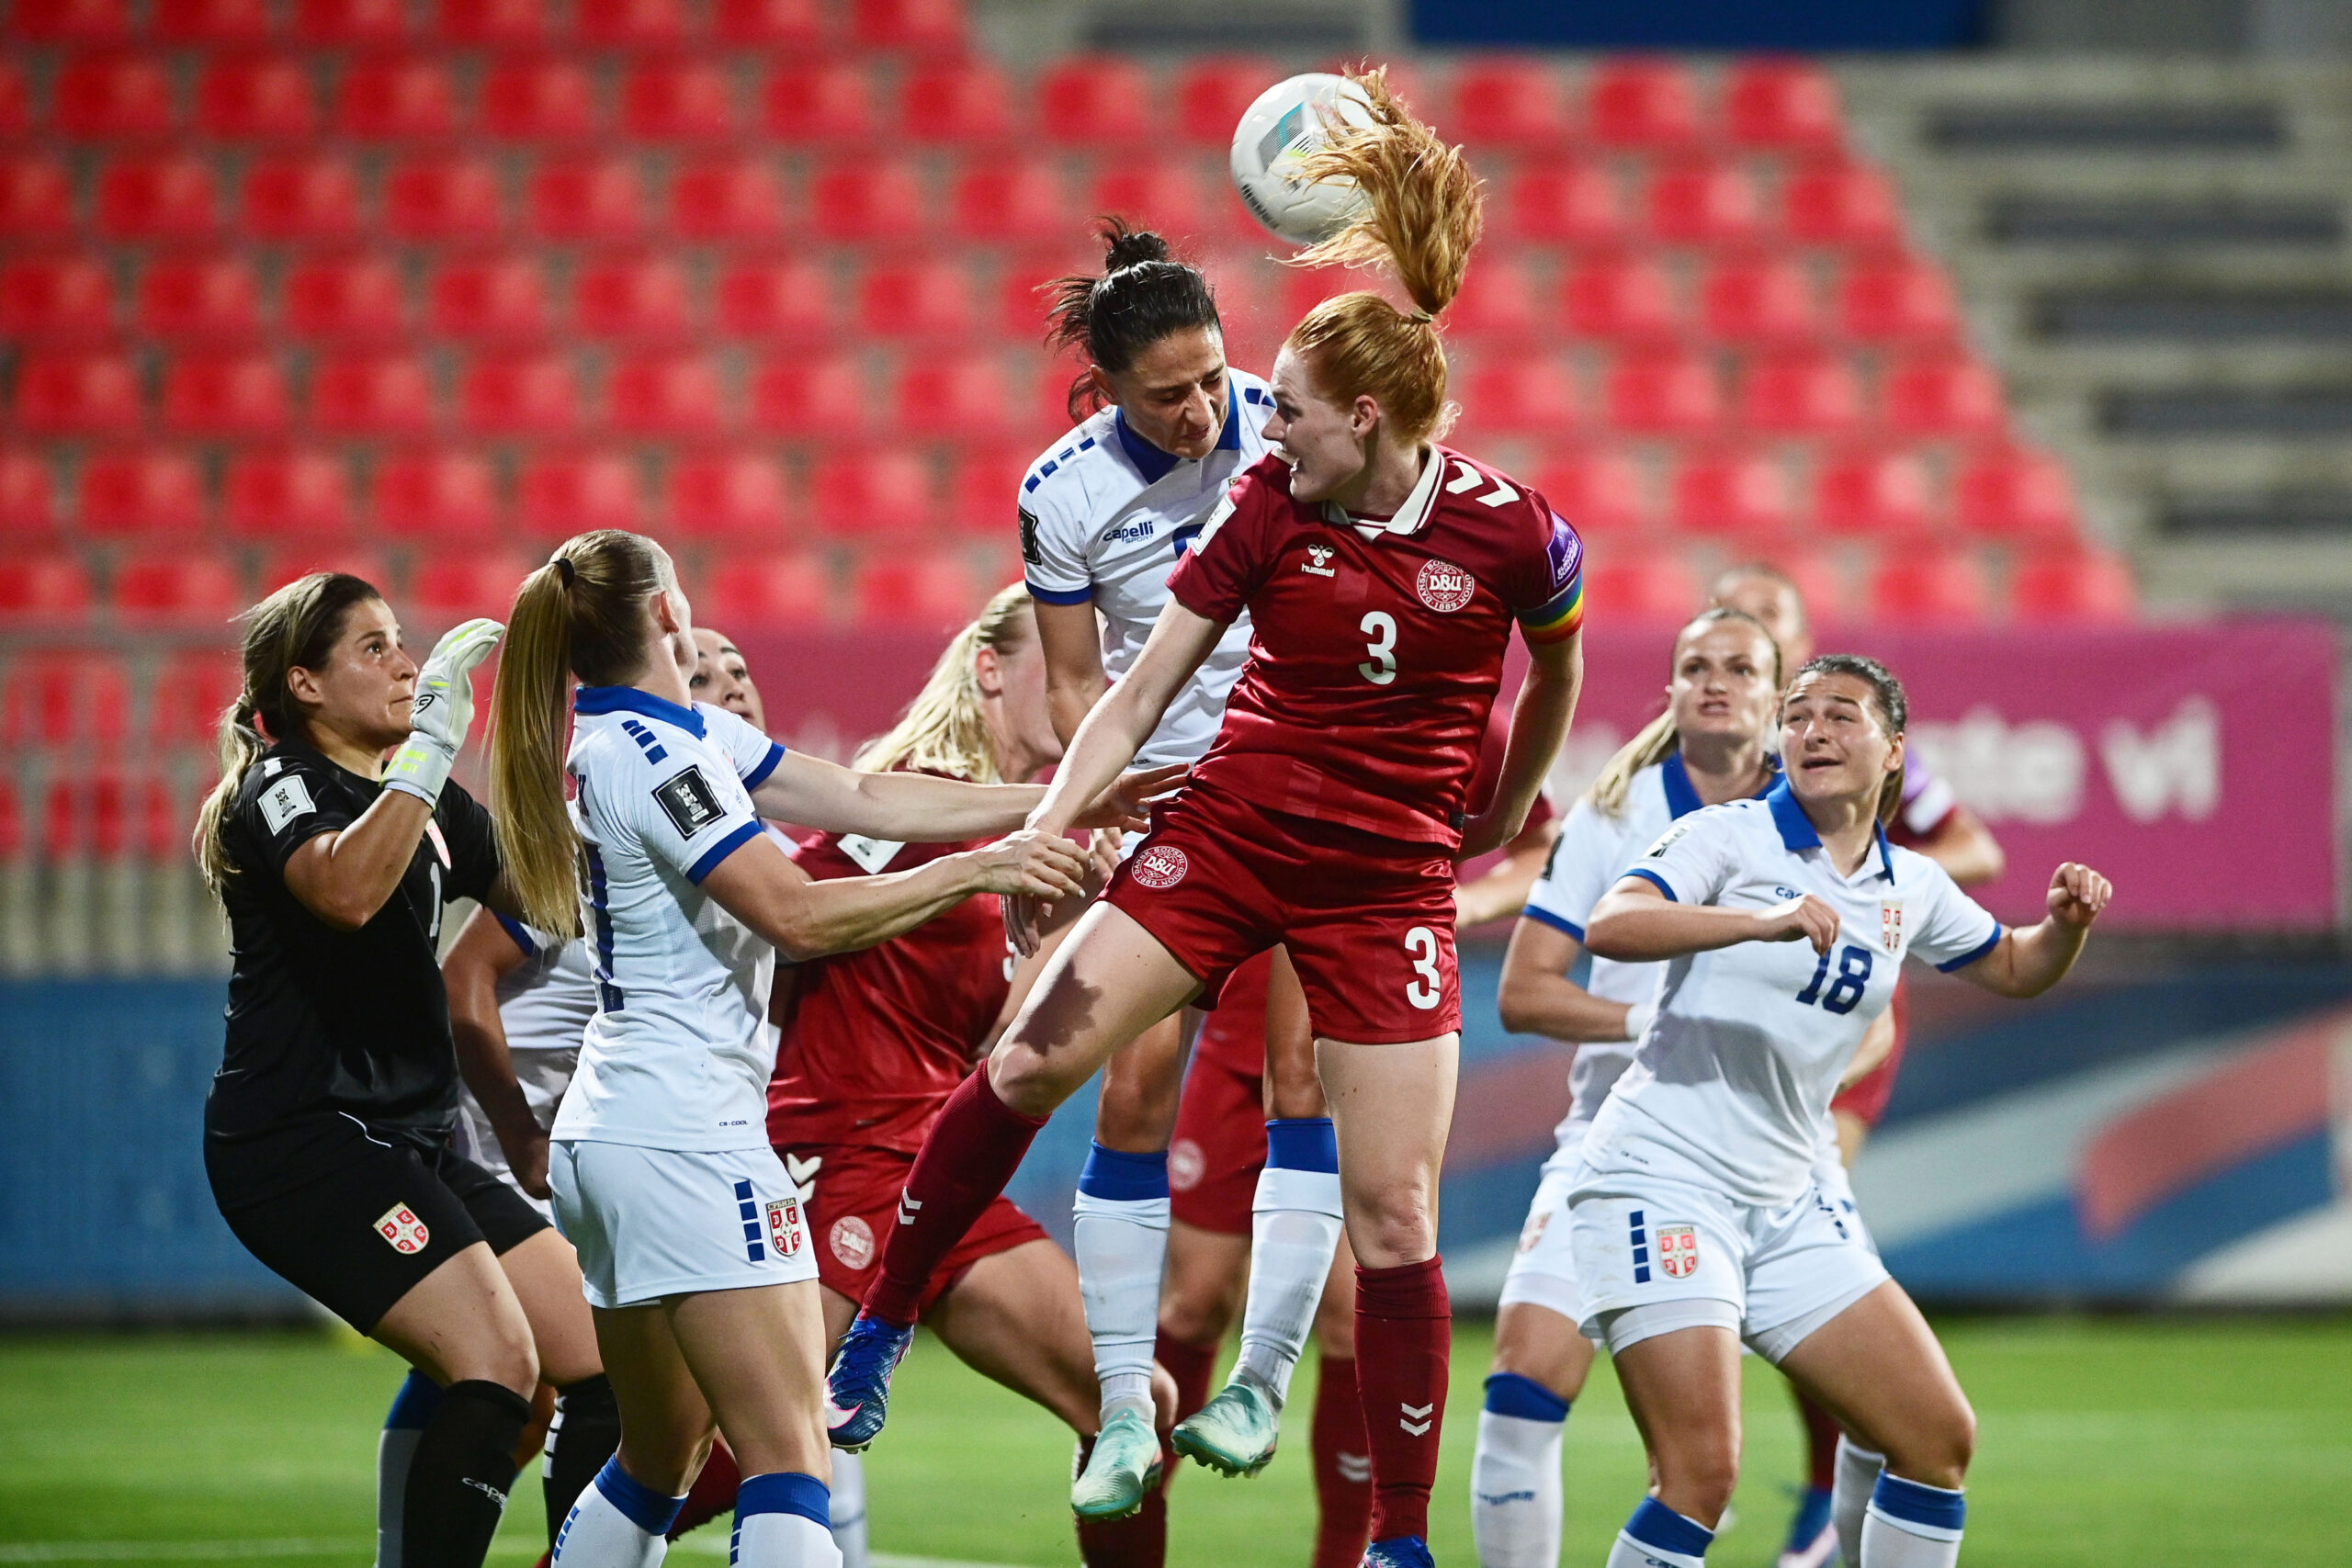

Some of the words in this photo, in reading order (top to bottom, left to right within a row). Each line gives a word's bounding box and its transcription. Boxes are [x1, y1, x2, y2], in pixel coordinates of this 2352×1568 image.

[1102, 521, 1154, 542] capelli
[1301, 562, 1335, 578] hummel
[1429, 574, 1462, 592] DBU
[1434, 602, 1457, 610] 1889
[1359, 611, 1396, 685] 3
[1143, 855, 1177, 876] DBU
[1405, 926, 1441, 1010] 3
[1795, 945, 1872, 1015] 18
